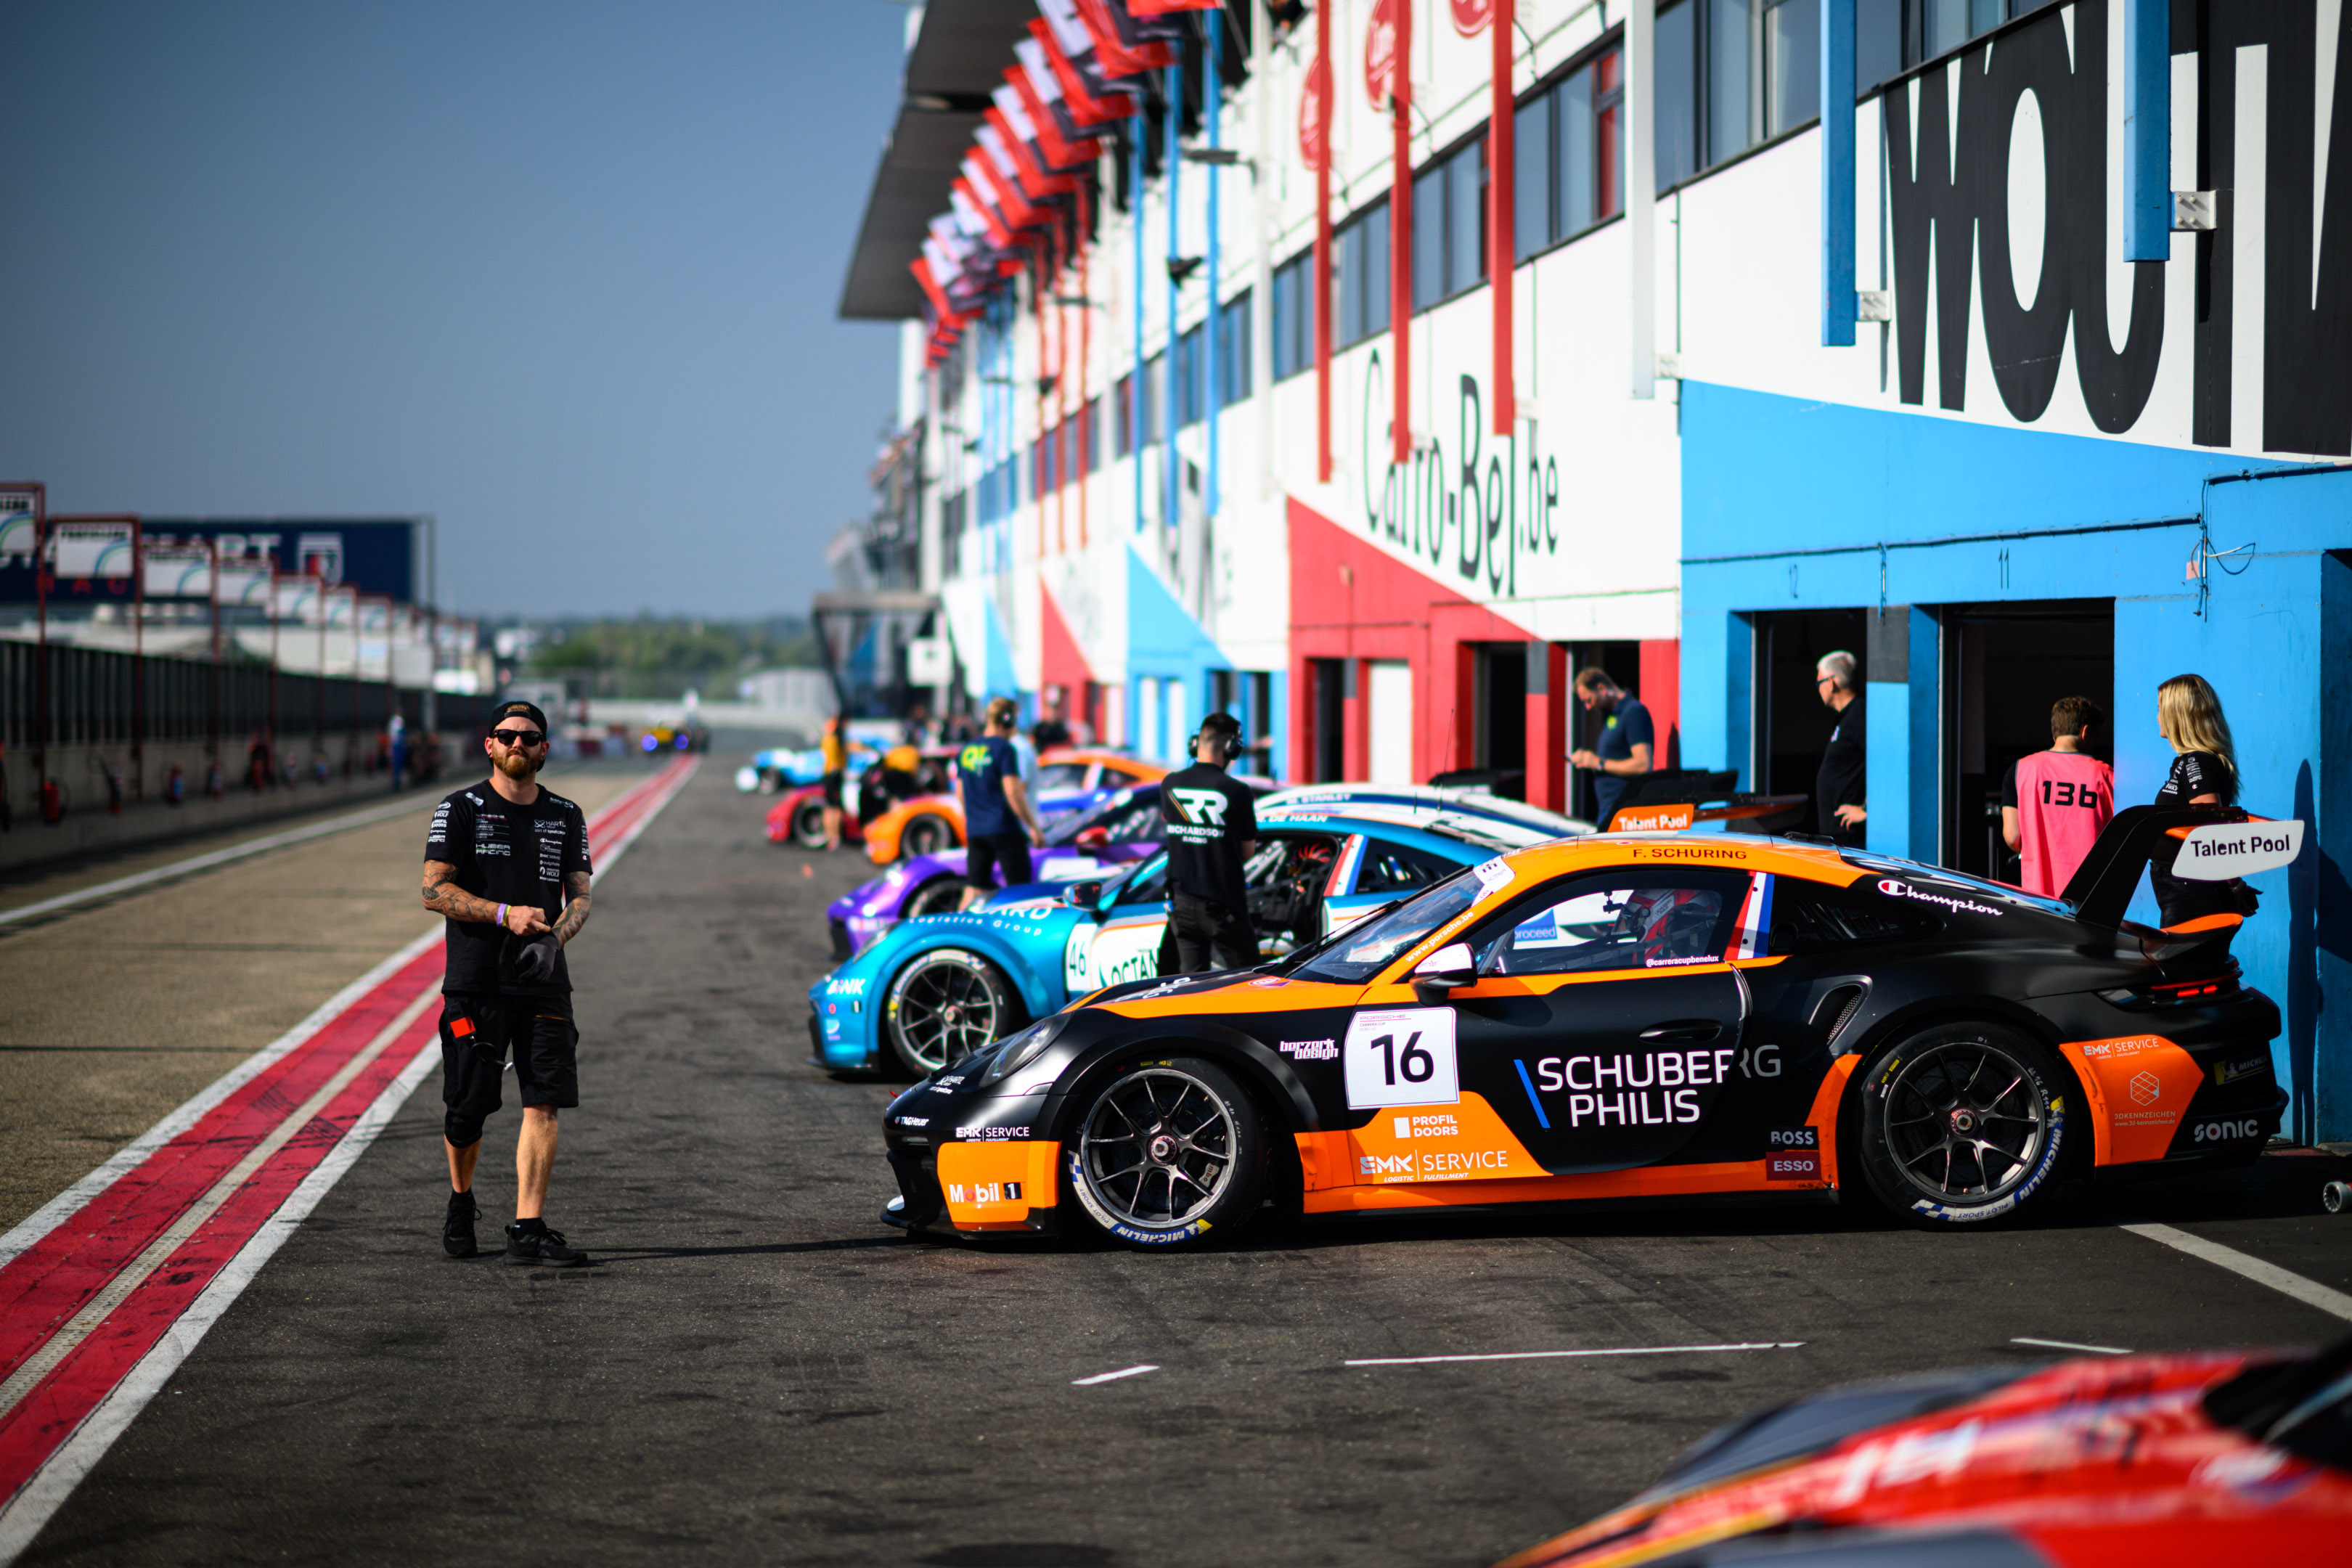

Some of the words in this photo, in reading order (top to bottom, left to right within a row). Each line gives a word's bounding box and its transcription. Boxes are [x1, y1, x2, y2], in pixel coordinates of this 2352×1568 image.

[1618, 816, 1658, 830] Talent
[1659, 813, 1688, 828] Pool
[1167, 825, 1225, 837] RICHARDSON
[2190, 838, 2247, 857] Talent
[2251, 834, 2290, 853] Pool
[1633, 849, 1646, 858] F.
[1651, 849, 1747, 859] SCHURING
[1877, 879, 2004, 916] Champion
[992, 919, 1042, 936] Group
[1405, 910, 1474, 963] www.porsche.be
[1069, 942, 1086, 976] 46
[1646, 955, 1720, 967] @carreracupbenelux
[1279, 1038, 1336, 1052] berzerk
[2083, 1042, 2111, 1056] EMK
[2114, 1037, 2160, 1053] SERVICE
[1294, 1048, 1339, 1060] design
[1371, 1031, 1434, 1086] 16
[1569, 1089, 1700, 1127] PHILIS
[2114, 1111, 2176, 1119] 3DKENNZEICHEN
[1412, 1114, 1458, 1126] PROFIL
[985, 1127, 1030, 1137] SERVICE
[1413, 1126, 1458, 1138] DOORS
[1771, 1131, 1814, 1145] BOSS
[1360, 1153, 1414, 1175] EMK
[1423, 1150, 1508, 1171] SERVICE
[1773, 1160, 1814, 1172] ESSO
[2018, 1128, 2063, 1201] MICHELIN
[1424, 1172, 1469, 1180] FULFILLMENT
[949, 1183, 1000, 1203] Mobil
[1008, 1183, 1016, 1199] 1
[1079, 1188, 1095, 1209] SPORT
[1092, 1209, 1109, 1224] PILOT
[1986, 1203, 2009, 1215] PILOT
[1116, 1226, 1185, 1243] MICHELIN
